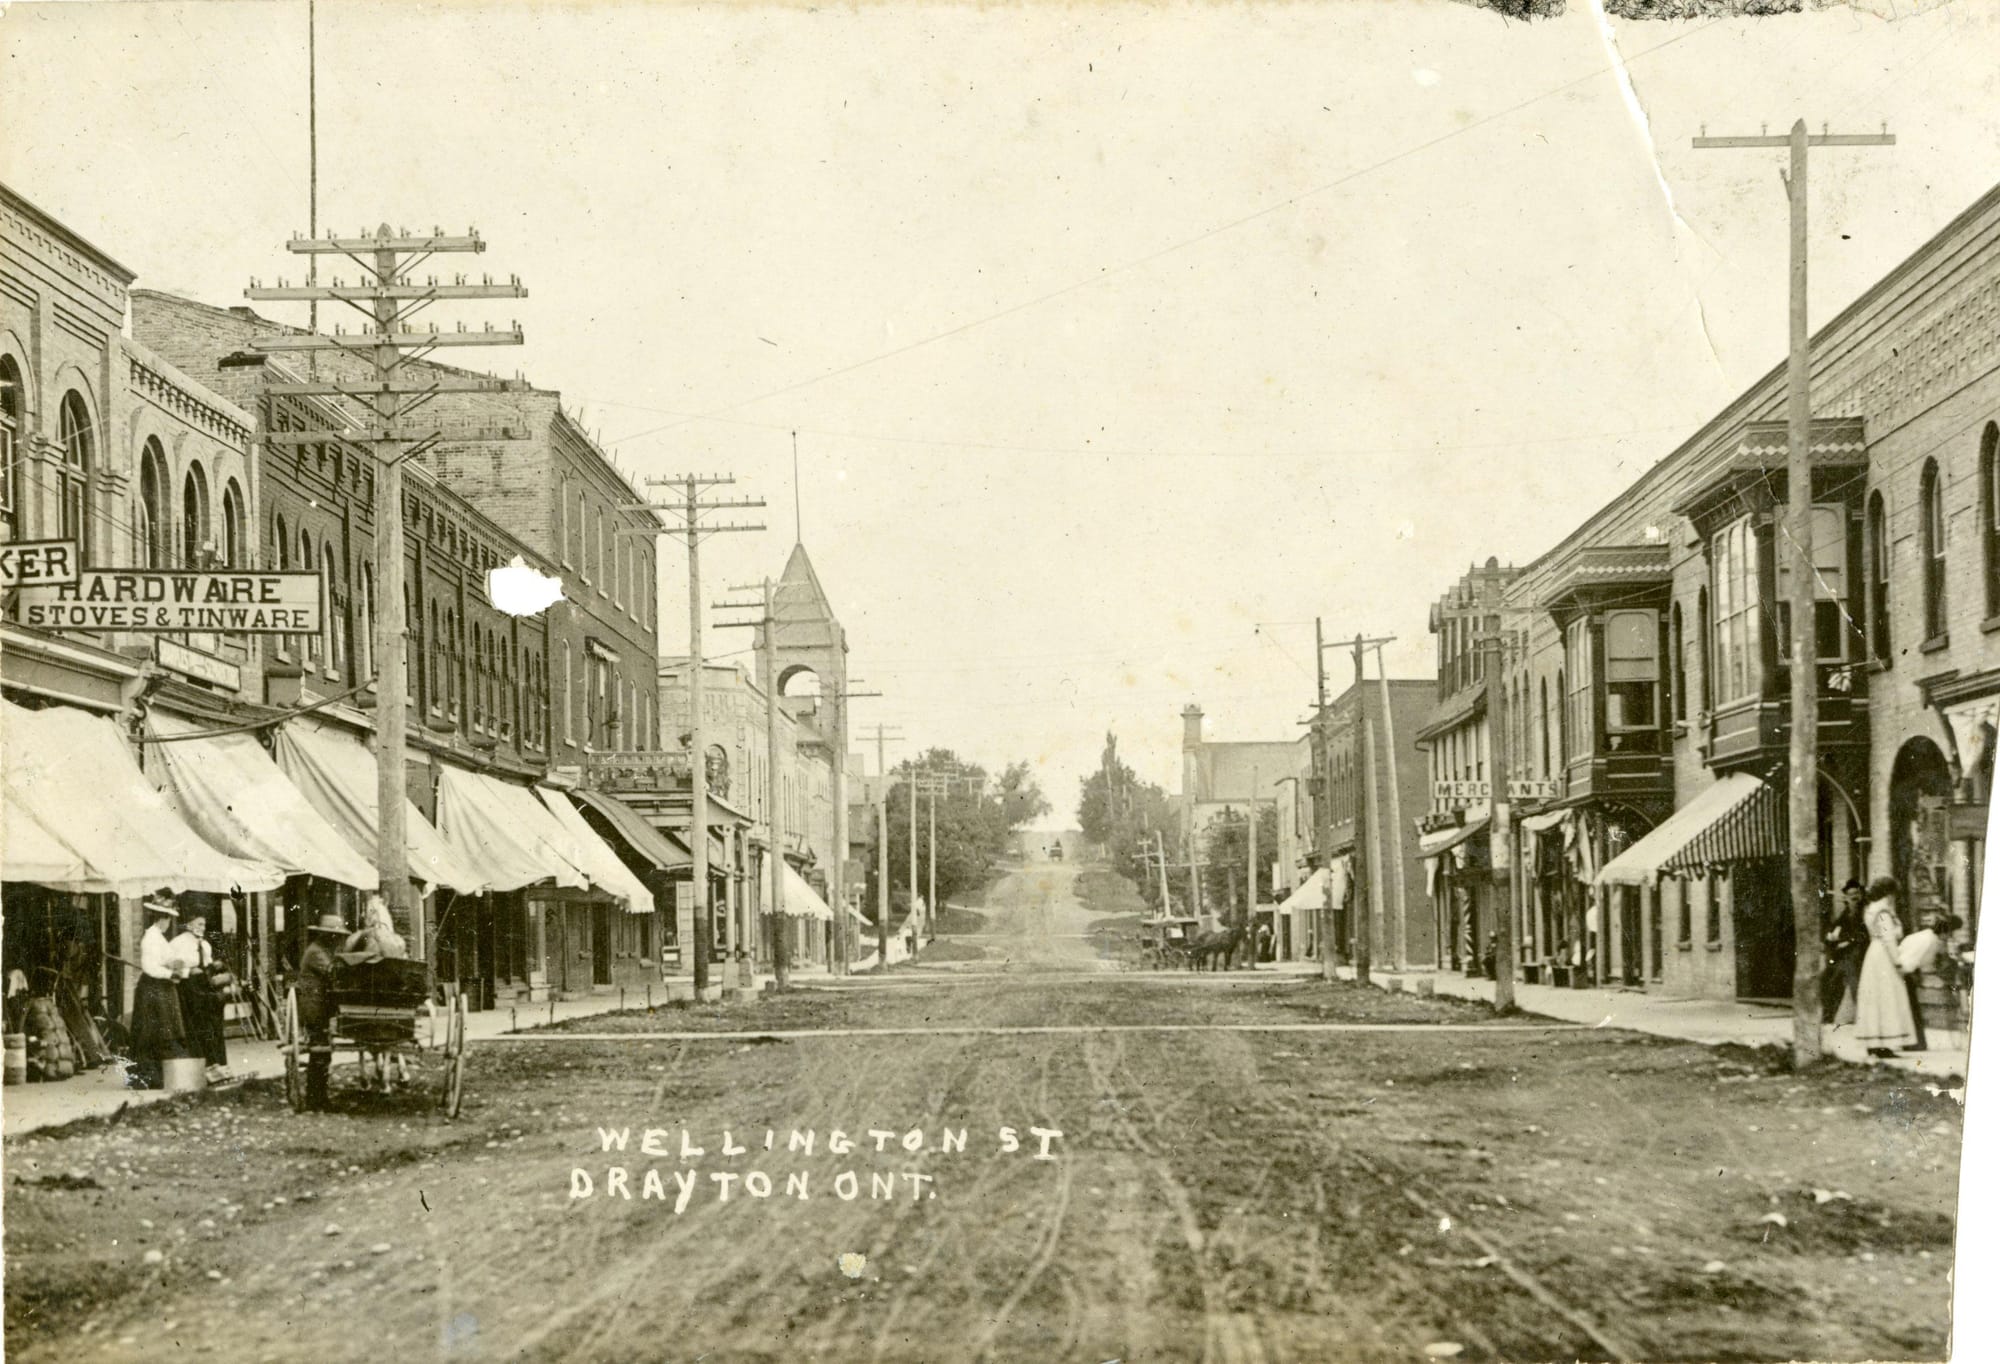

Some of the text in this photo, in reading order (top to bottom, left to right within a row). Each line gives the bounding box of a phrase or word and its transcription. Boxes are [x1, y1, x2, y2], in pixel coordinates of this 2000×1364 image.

[58, 575, 281, 604] HARDWARE
[28, 605, 310, 629] STOVES & TINWARE
[1438, 783, 1558, 796] MERCANTS
